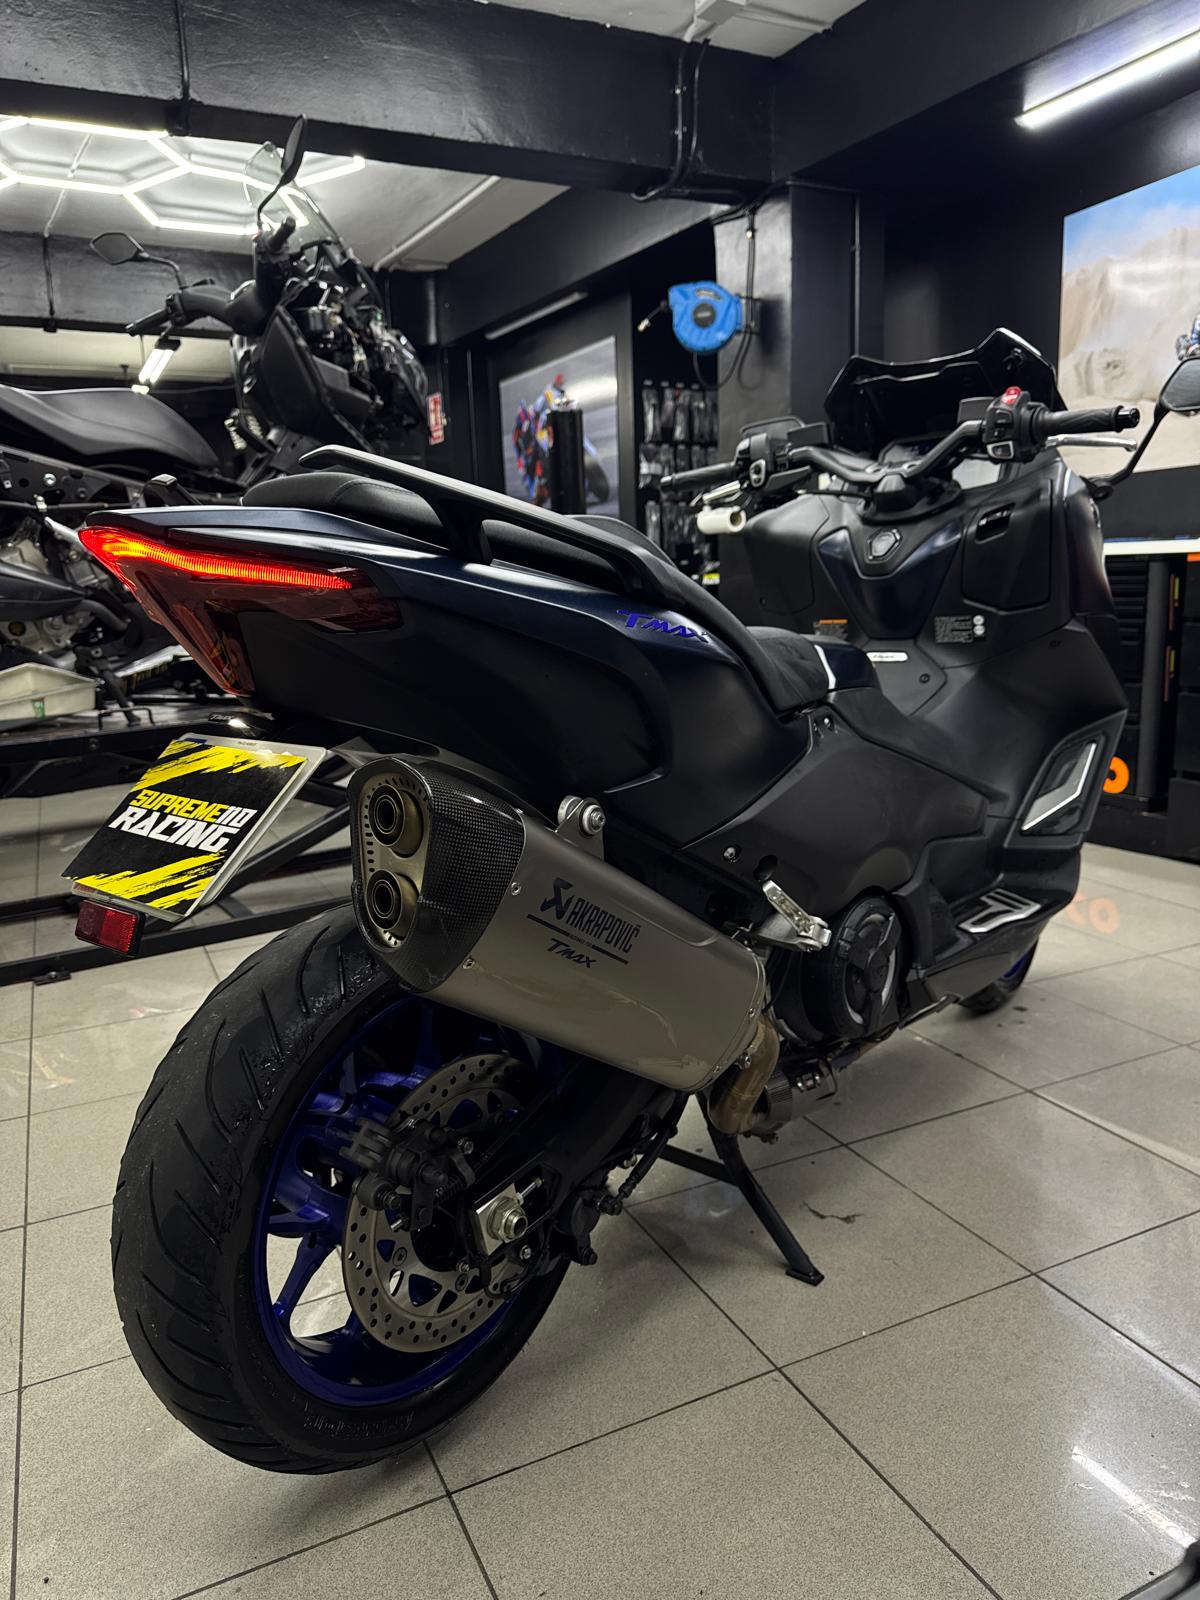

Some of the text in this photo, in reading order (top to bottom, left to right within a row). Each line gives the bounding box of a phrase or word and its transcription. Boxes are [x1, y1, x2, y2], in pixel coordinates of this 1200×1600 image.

[616, 609, 709, 643] TMAX
[108, 806, 240, 853] RACING
[547, 938, 597, 968] TMAX
